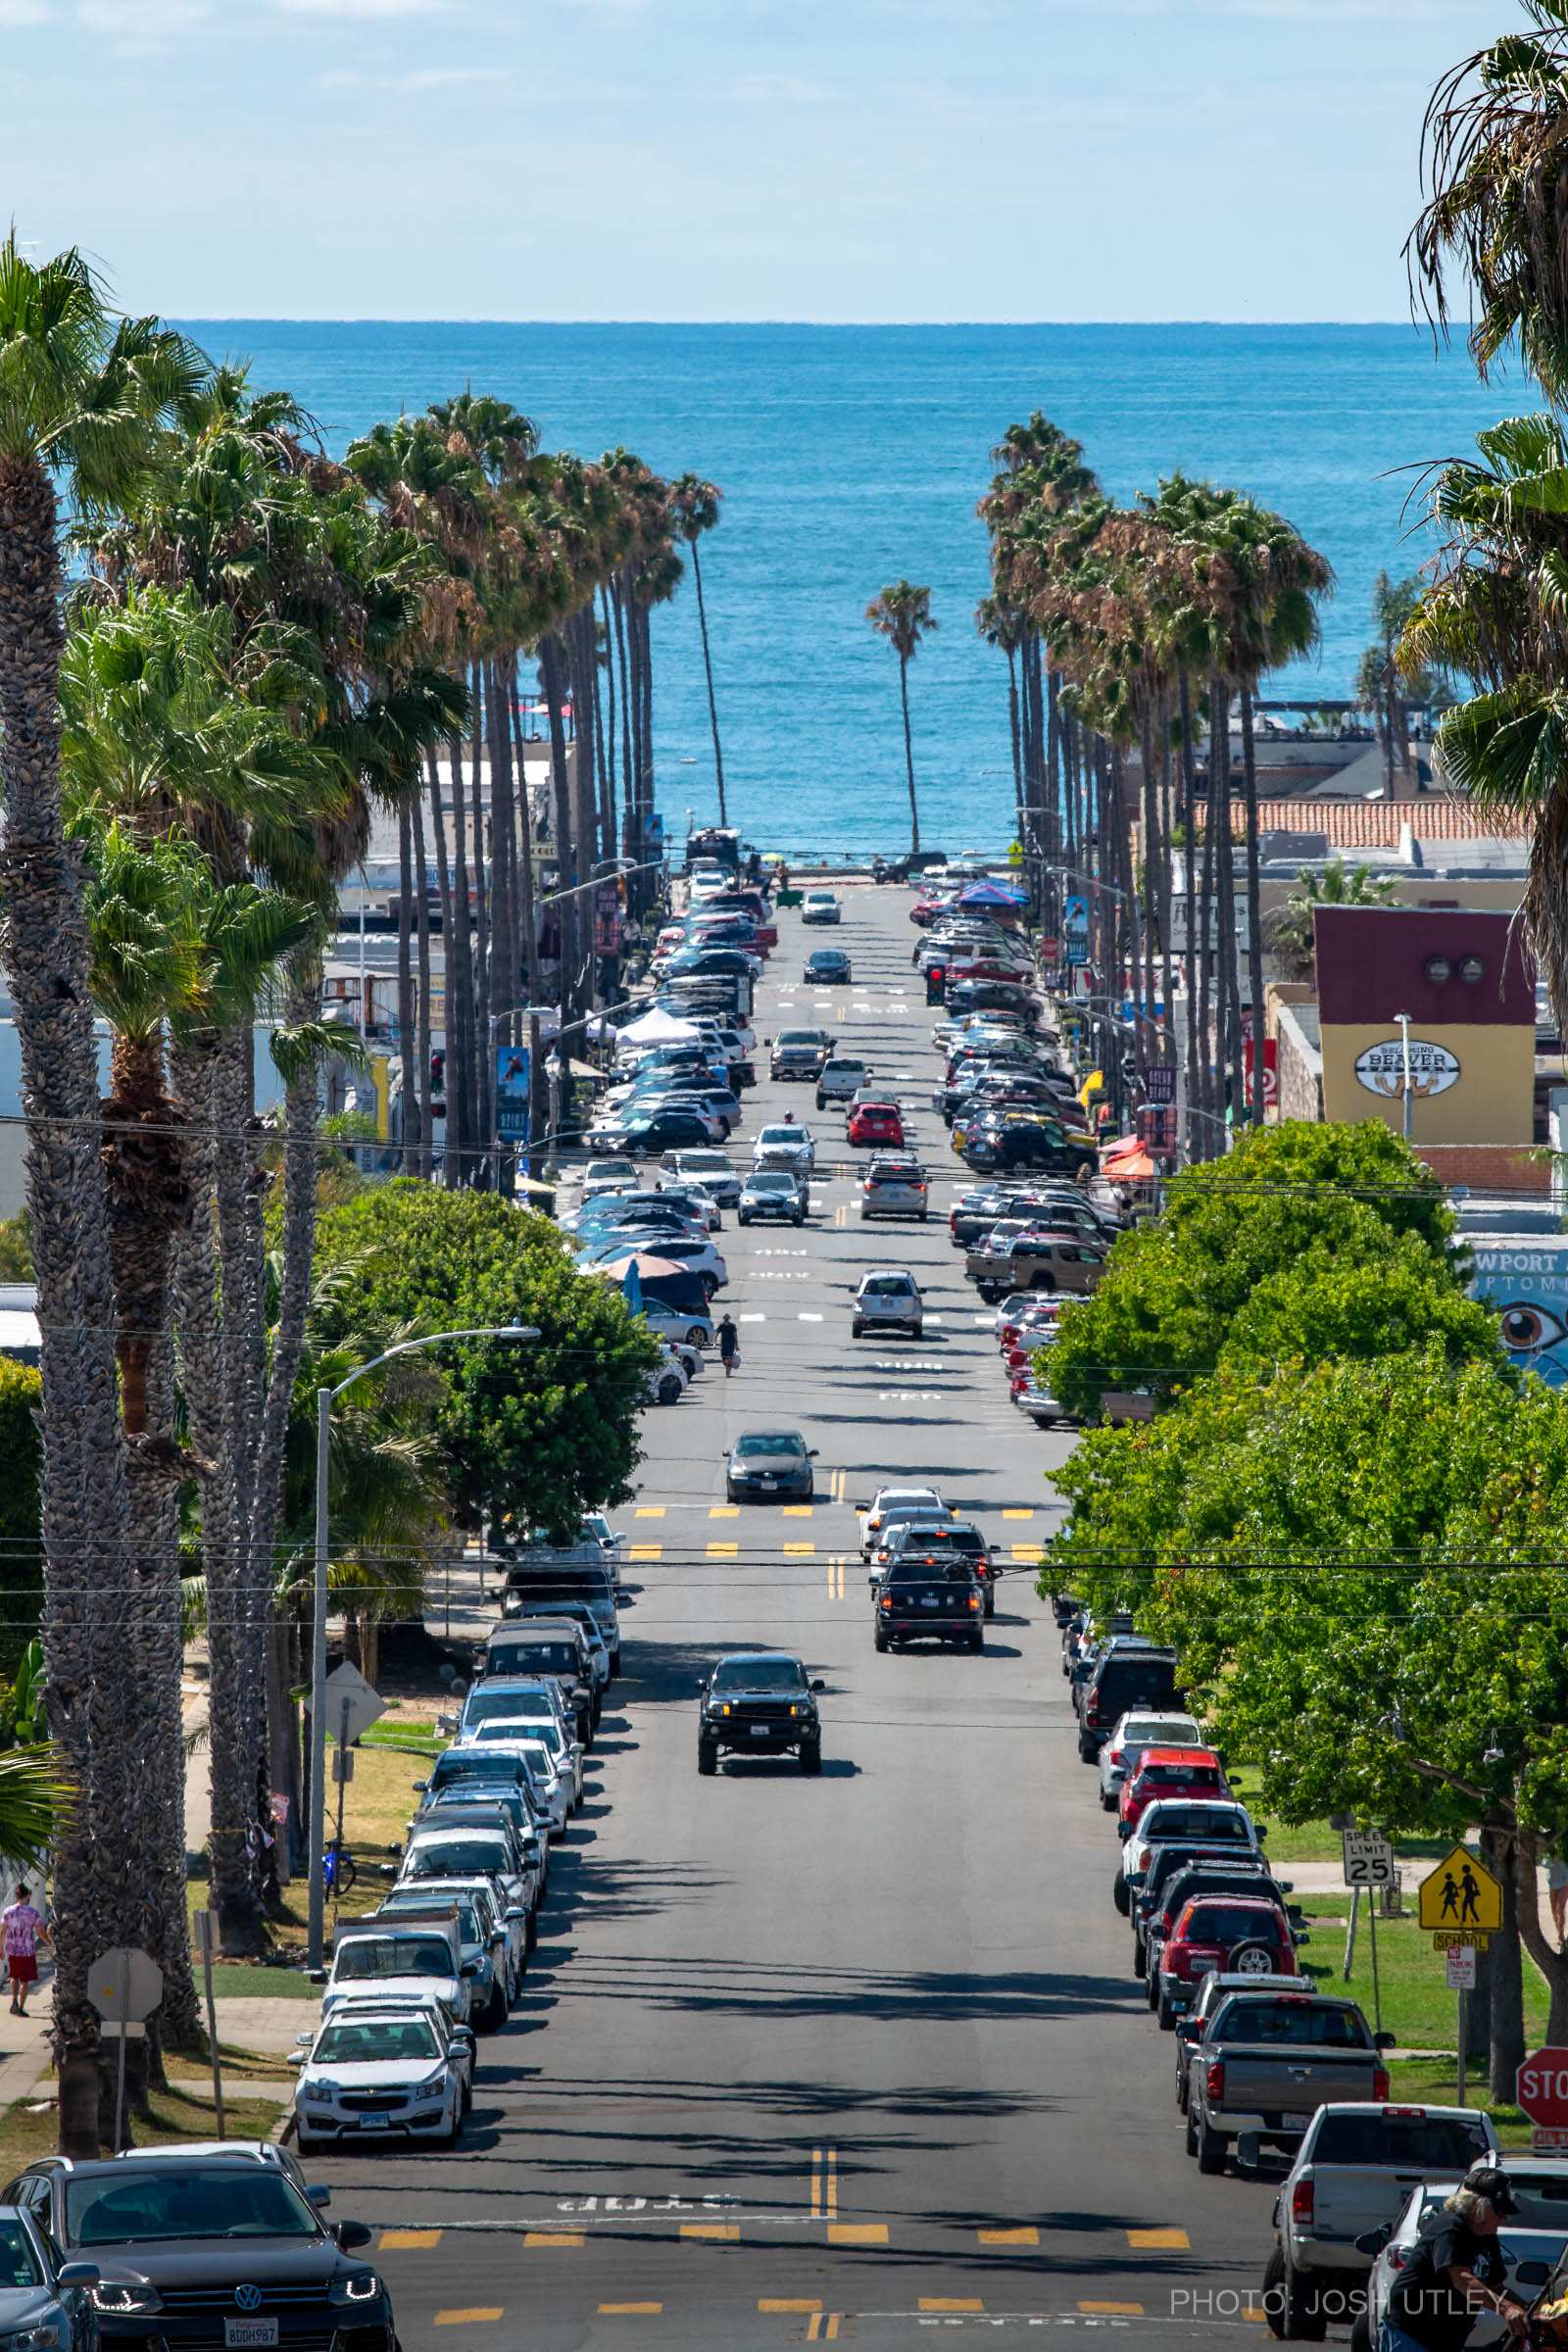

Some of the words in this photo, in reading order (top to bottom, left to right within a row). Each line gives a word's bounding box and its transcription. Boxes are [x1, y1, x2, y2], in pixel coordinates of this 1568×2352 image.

[1369, 1054, 1446, 1066] BEAVER
[1474, 1254, 1559, 1271] WPORT
[1347, 1832, 1380, 1842] SPEE
[1350, 1844, 1386, 1855] LIMIT
[1350, 1858, 1389, 1881] 25
[1437, 1935, 1487, 1949] SCHOOL
[1523, 2070, 1568, 2100] STO
